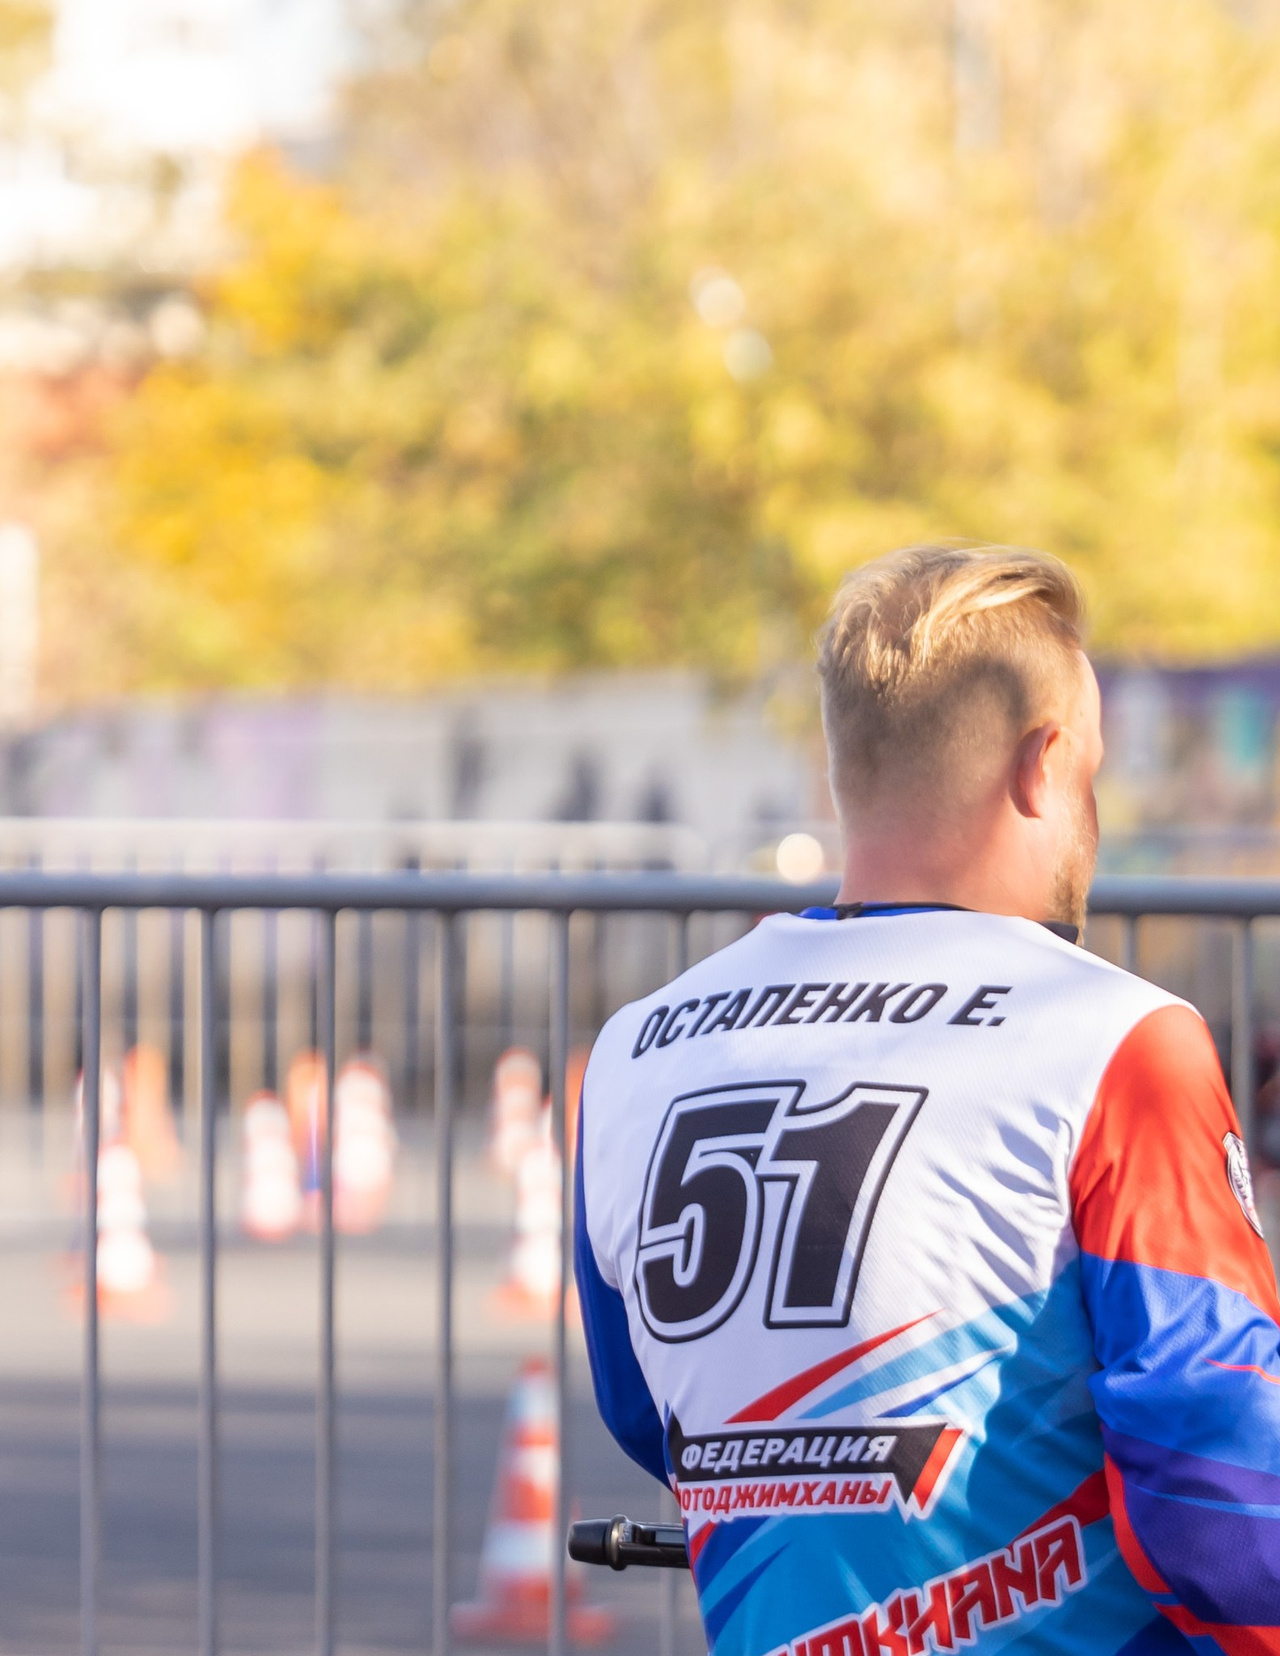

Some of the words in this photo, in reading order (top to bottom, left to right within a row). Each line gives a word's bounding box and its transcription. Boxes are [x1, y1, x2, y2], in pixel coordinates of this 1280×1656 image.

[632, 982, 943, 1060] ОСТАПЕНКО
[949, 985, 1014, 1028] Е.
[635, 1079, 929, 1344] 51
[681, 1435, 898, 1473] ФЕДЕРАЦИЯ
[679, 1480, 893, 1514] ОТОДЖИМХАНЫ
